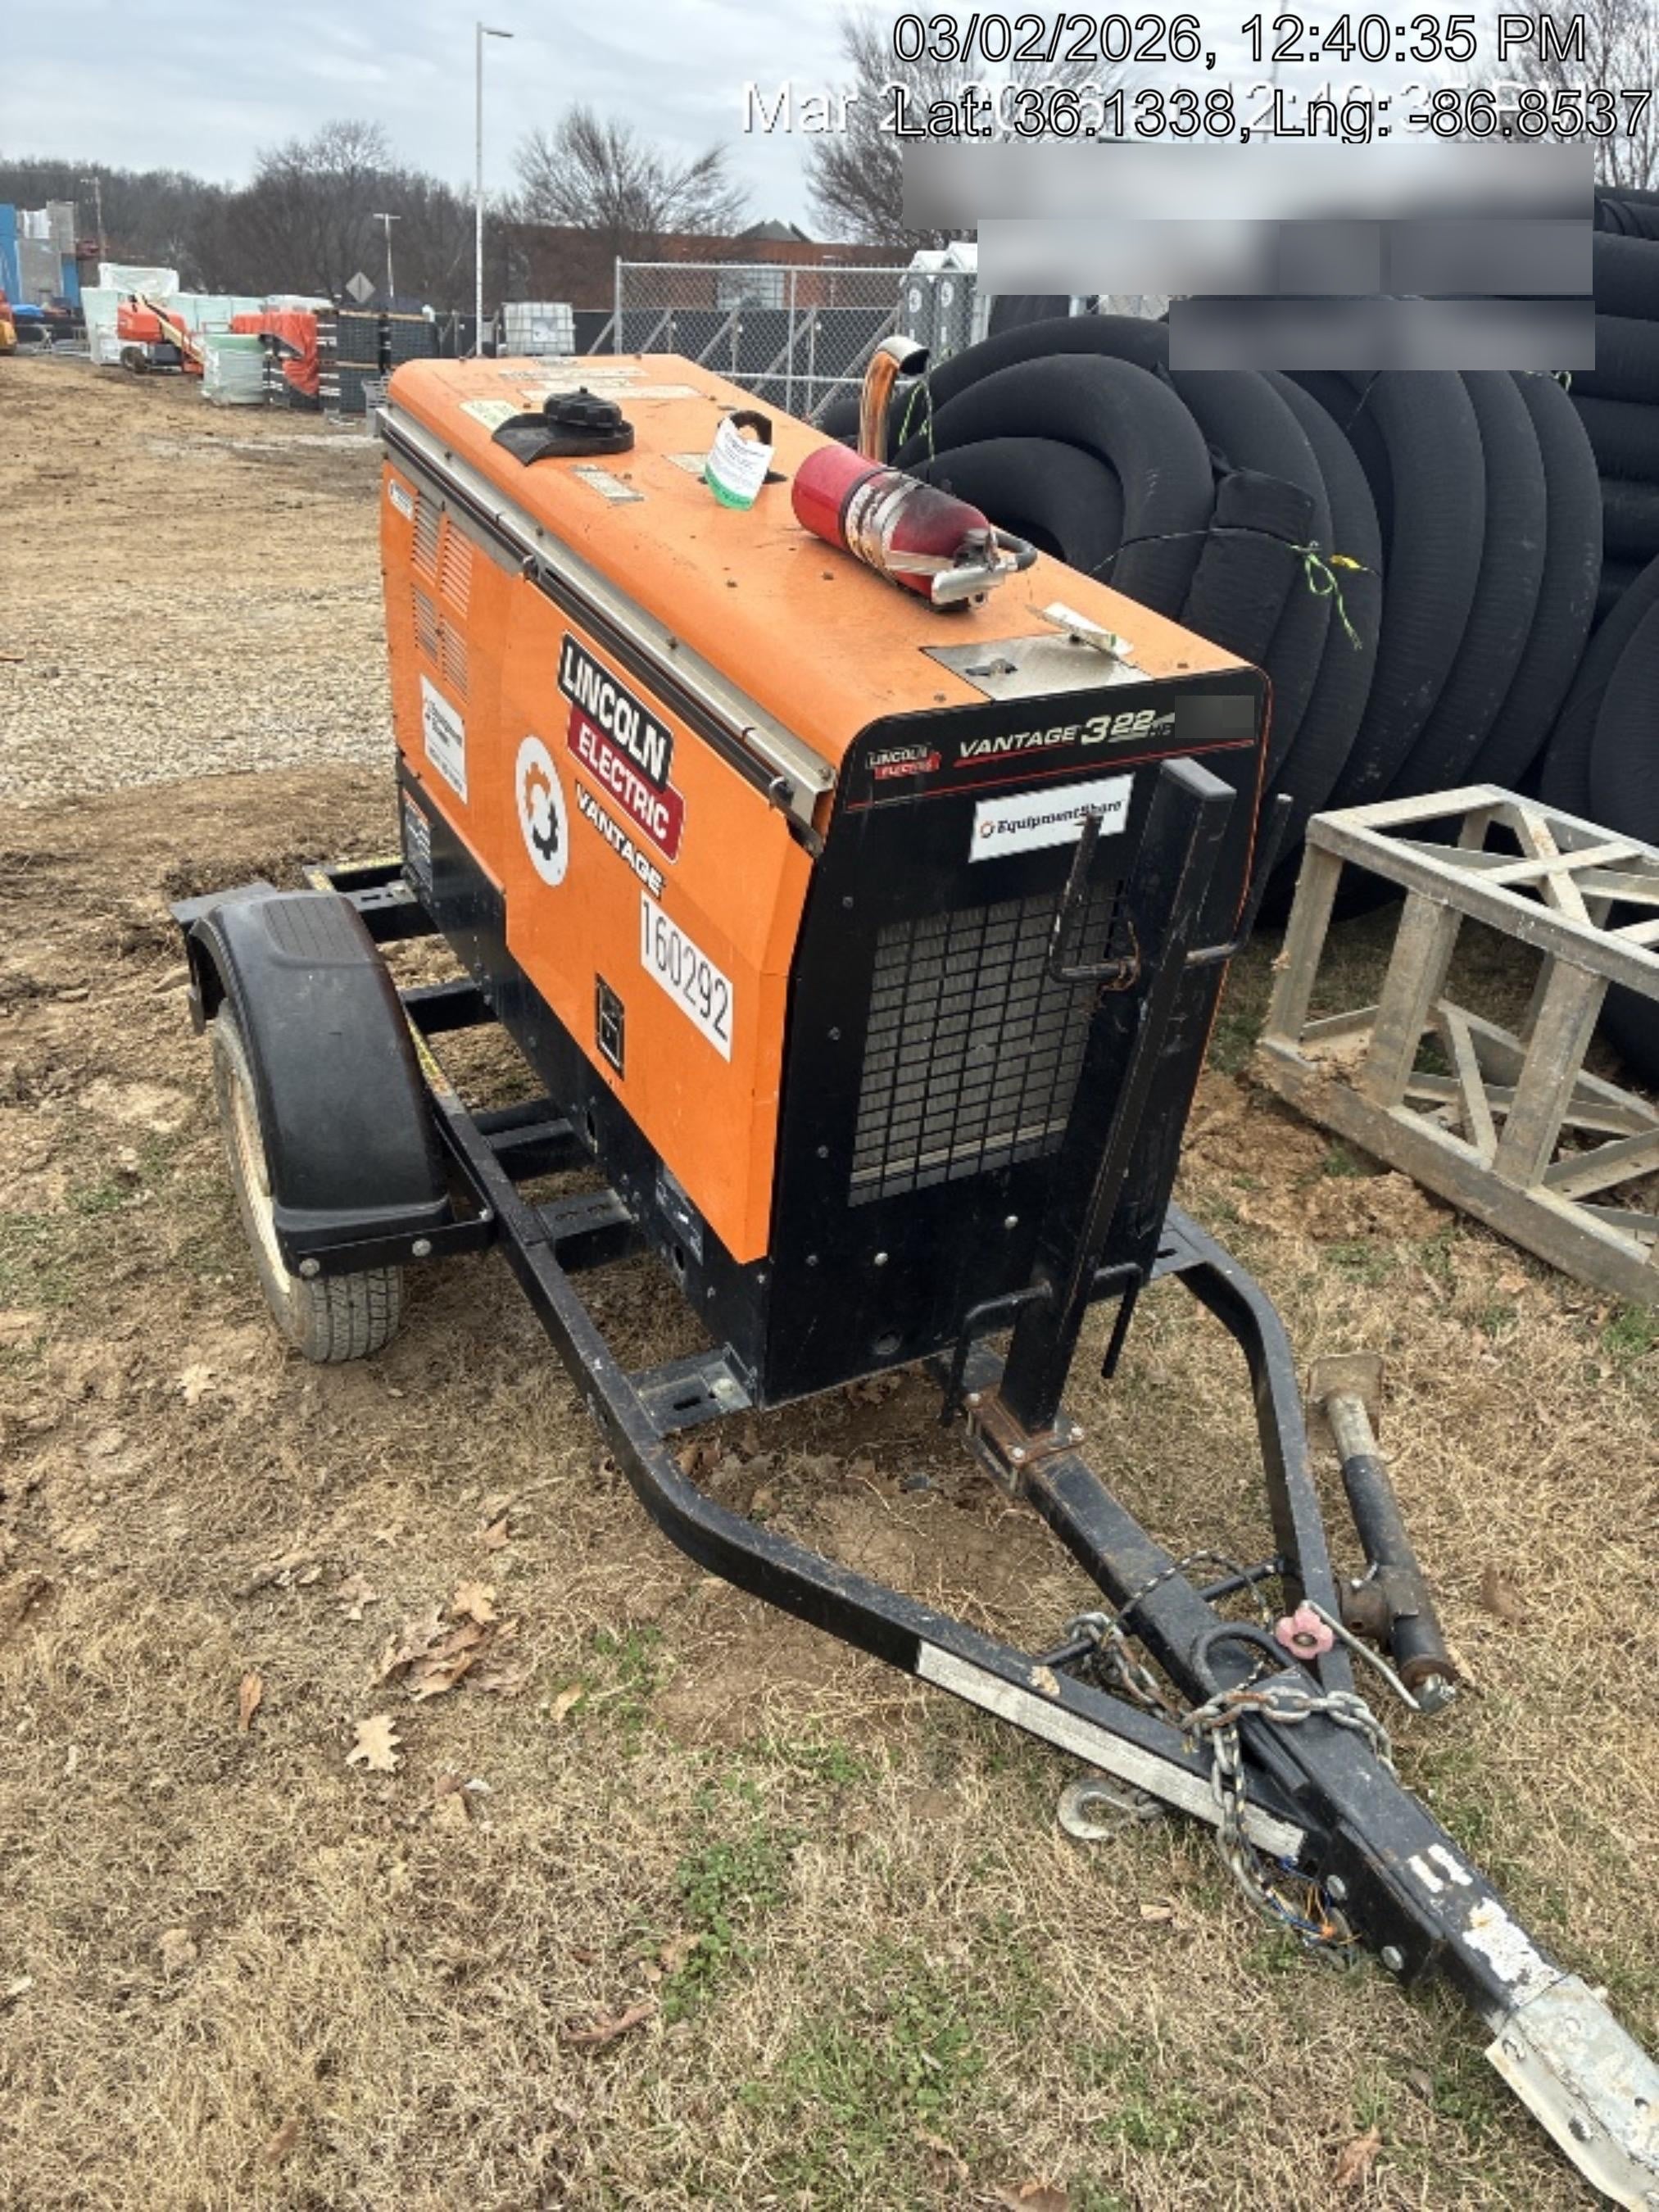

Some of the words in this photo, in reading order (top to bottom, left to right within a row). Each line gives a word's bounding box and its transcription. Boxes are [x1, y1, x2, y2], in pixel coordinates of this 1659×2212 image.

[563, 646, 666, 782] LINCOLN
[869, 746, 928, 767] LINCOLN
[959, 725, 1080, 758] VANTAGE
[1081, 709, 1156, 744] 322
[578, 722, 669, 840] ELECTRIC
[575, 782, 664, 897] VANTAGE
[642, 900, 728, 1041] 160292
